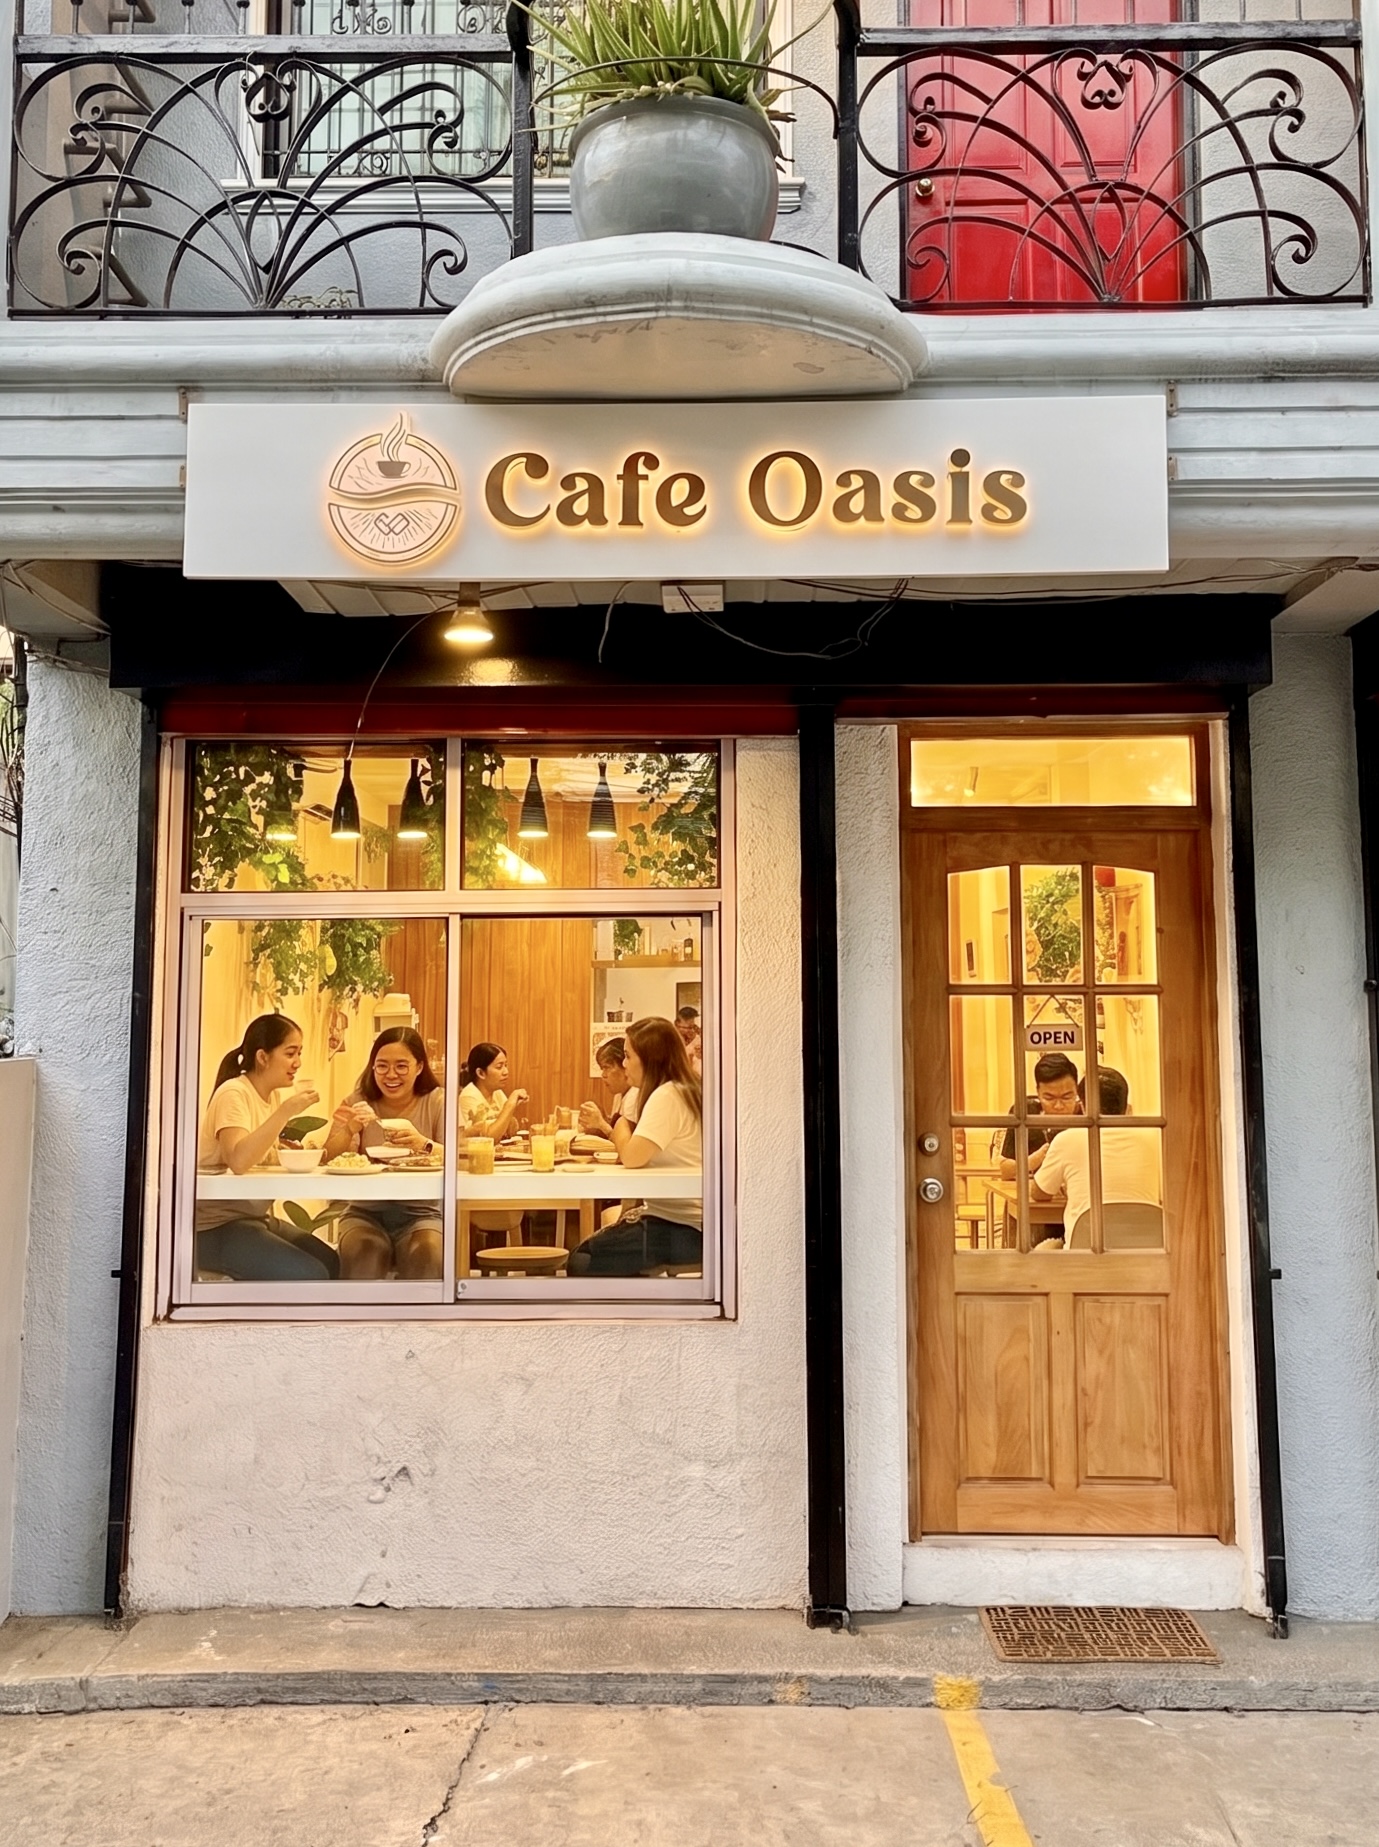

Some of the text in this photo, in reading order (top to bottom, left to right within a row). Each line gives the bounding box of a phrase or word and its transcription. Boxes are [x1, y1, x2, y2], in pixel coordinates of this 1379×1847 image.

[485, 449, 1027, 527] Cafe Oasis
[1030, 1031, 1075, 1045] OPEN
